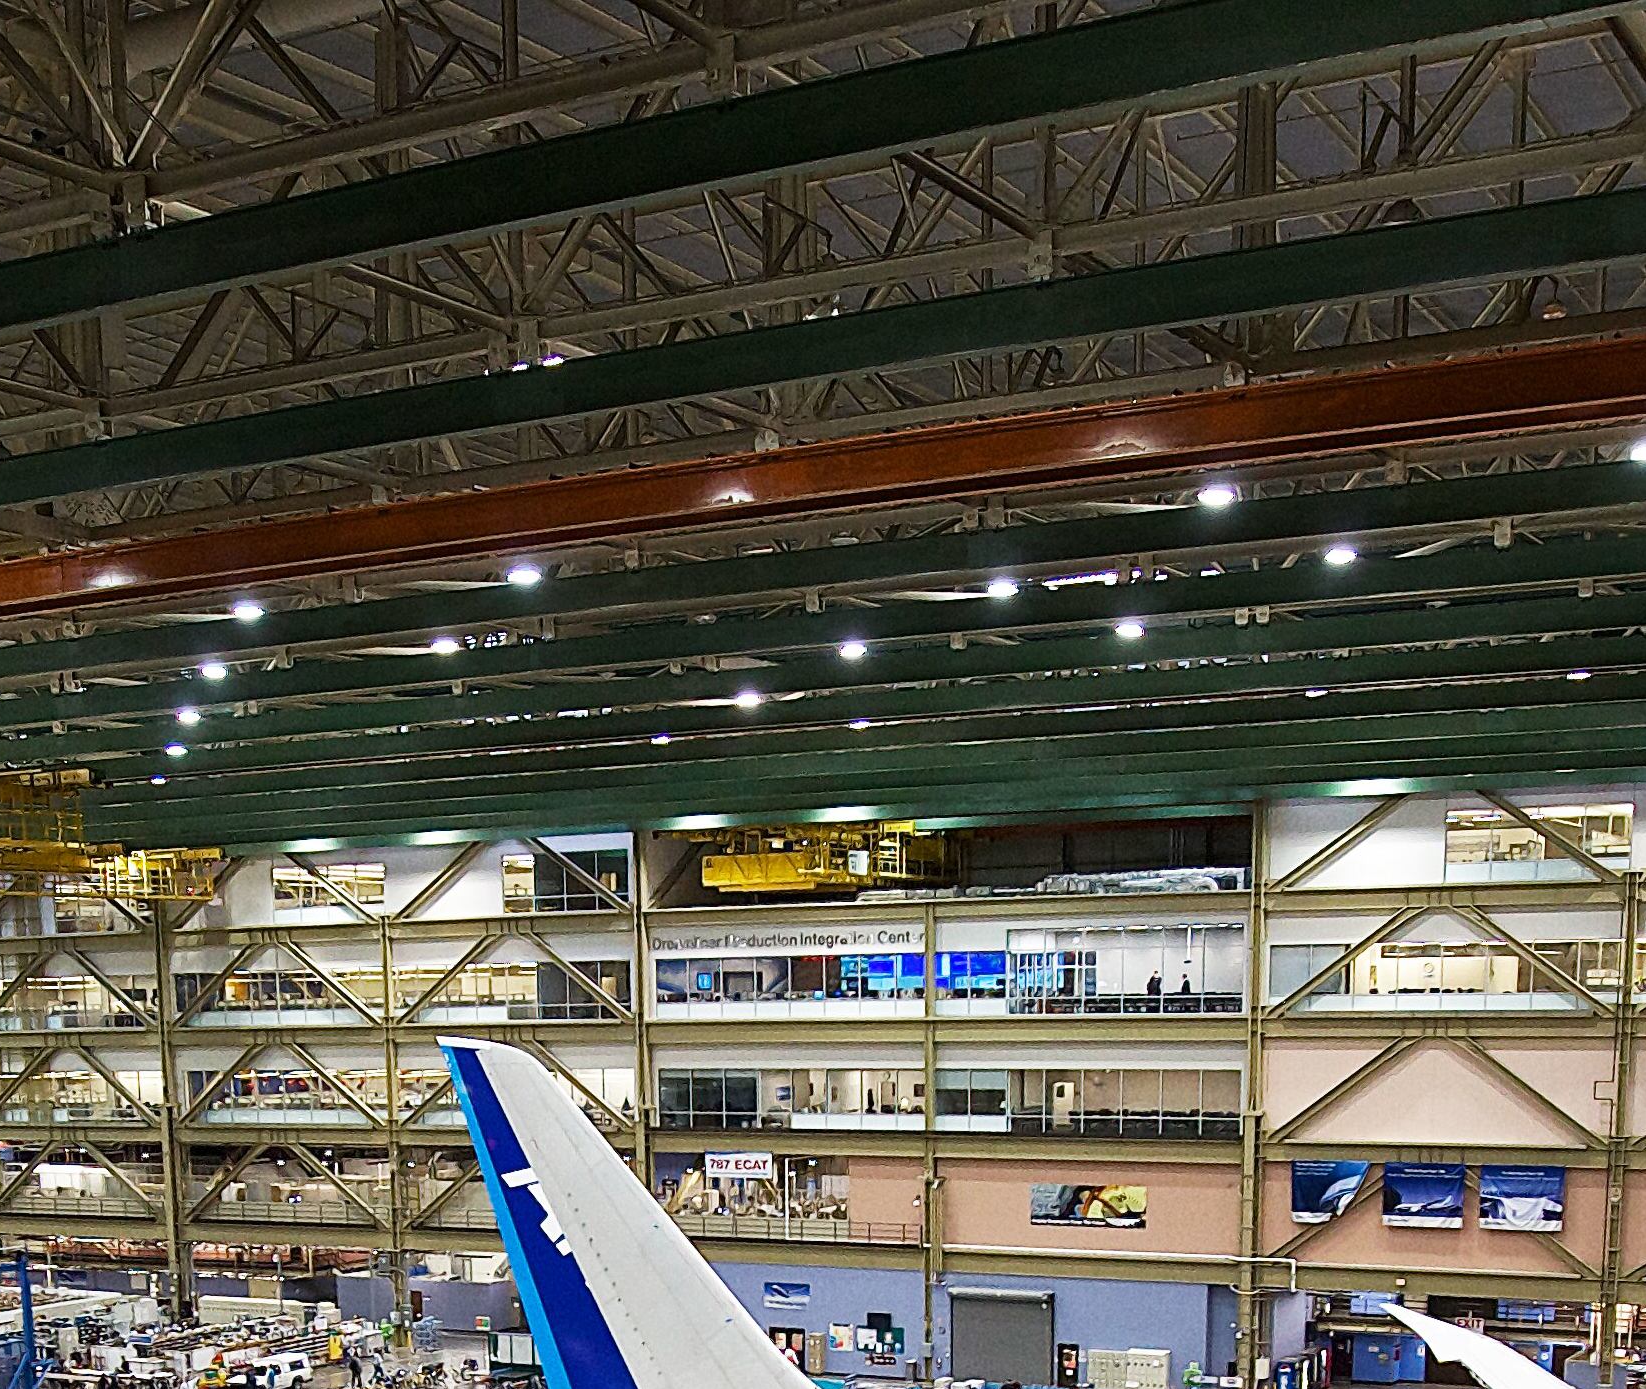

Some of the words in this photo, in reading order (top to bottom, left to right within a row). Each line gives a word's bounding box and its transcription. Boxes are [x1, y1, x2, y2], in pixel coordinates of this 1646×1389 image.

[709, 1157, 730, 1170] 787
[734, 1158, 768, 1171] ECAT
[1456, 1318, 1483, 1329] EXIT
